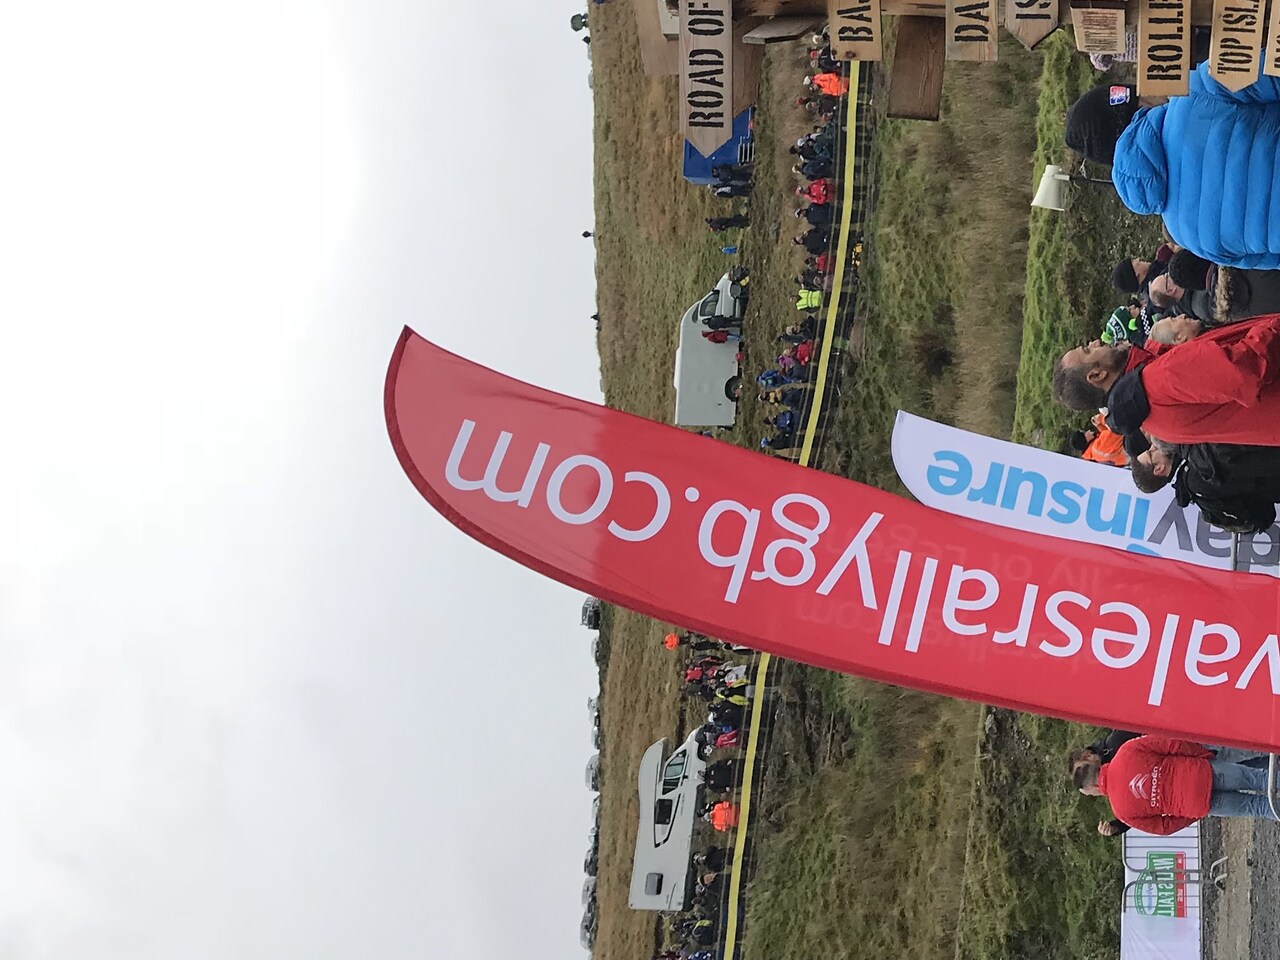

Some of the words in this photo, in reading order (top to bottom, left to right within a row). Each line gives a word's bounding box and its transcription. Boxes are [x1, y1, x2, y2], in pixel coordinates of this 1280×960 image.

[687, 1, 725, 37] OF
[1217, 37, 1253, 75] TOP
[687, 48, 725, 128] ROAD
